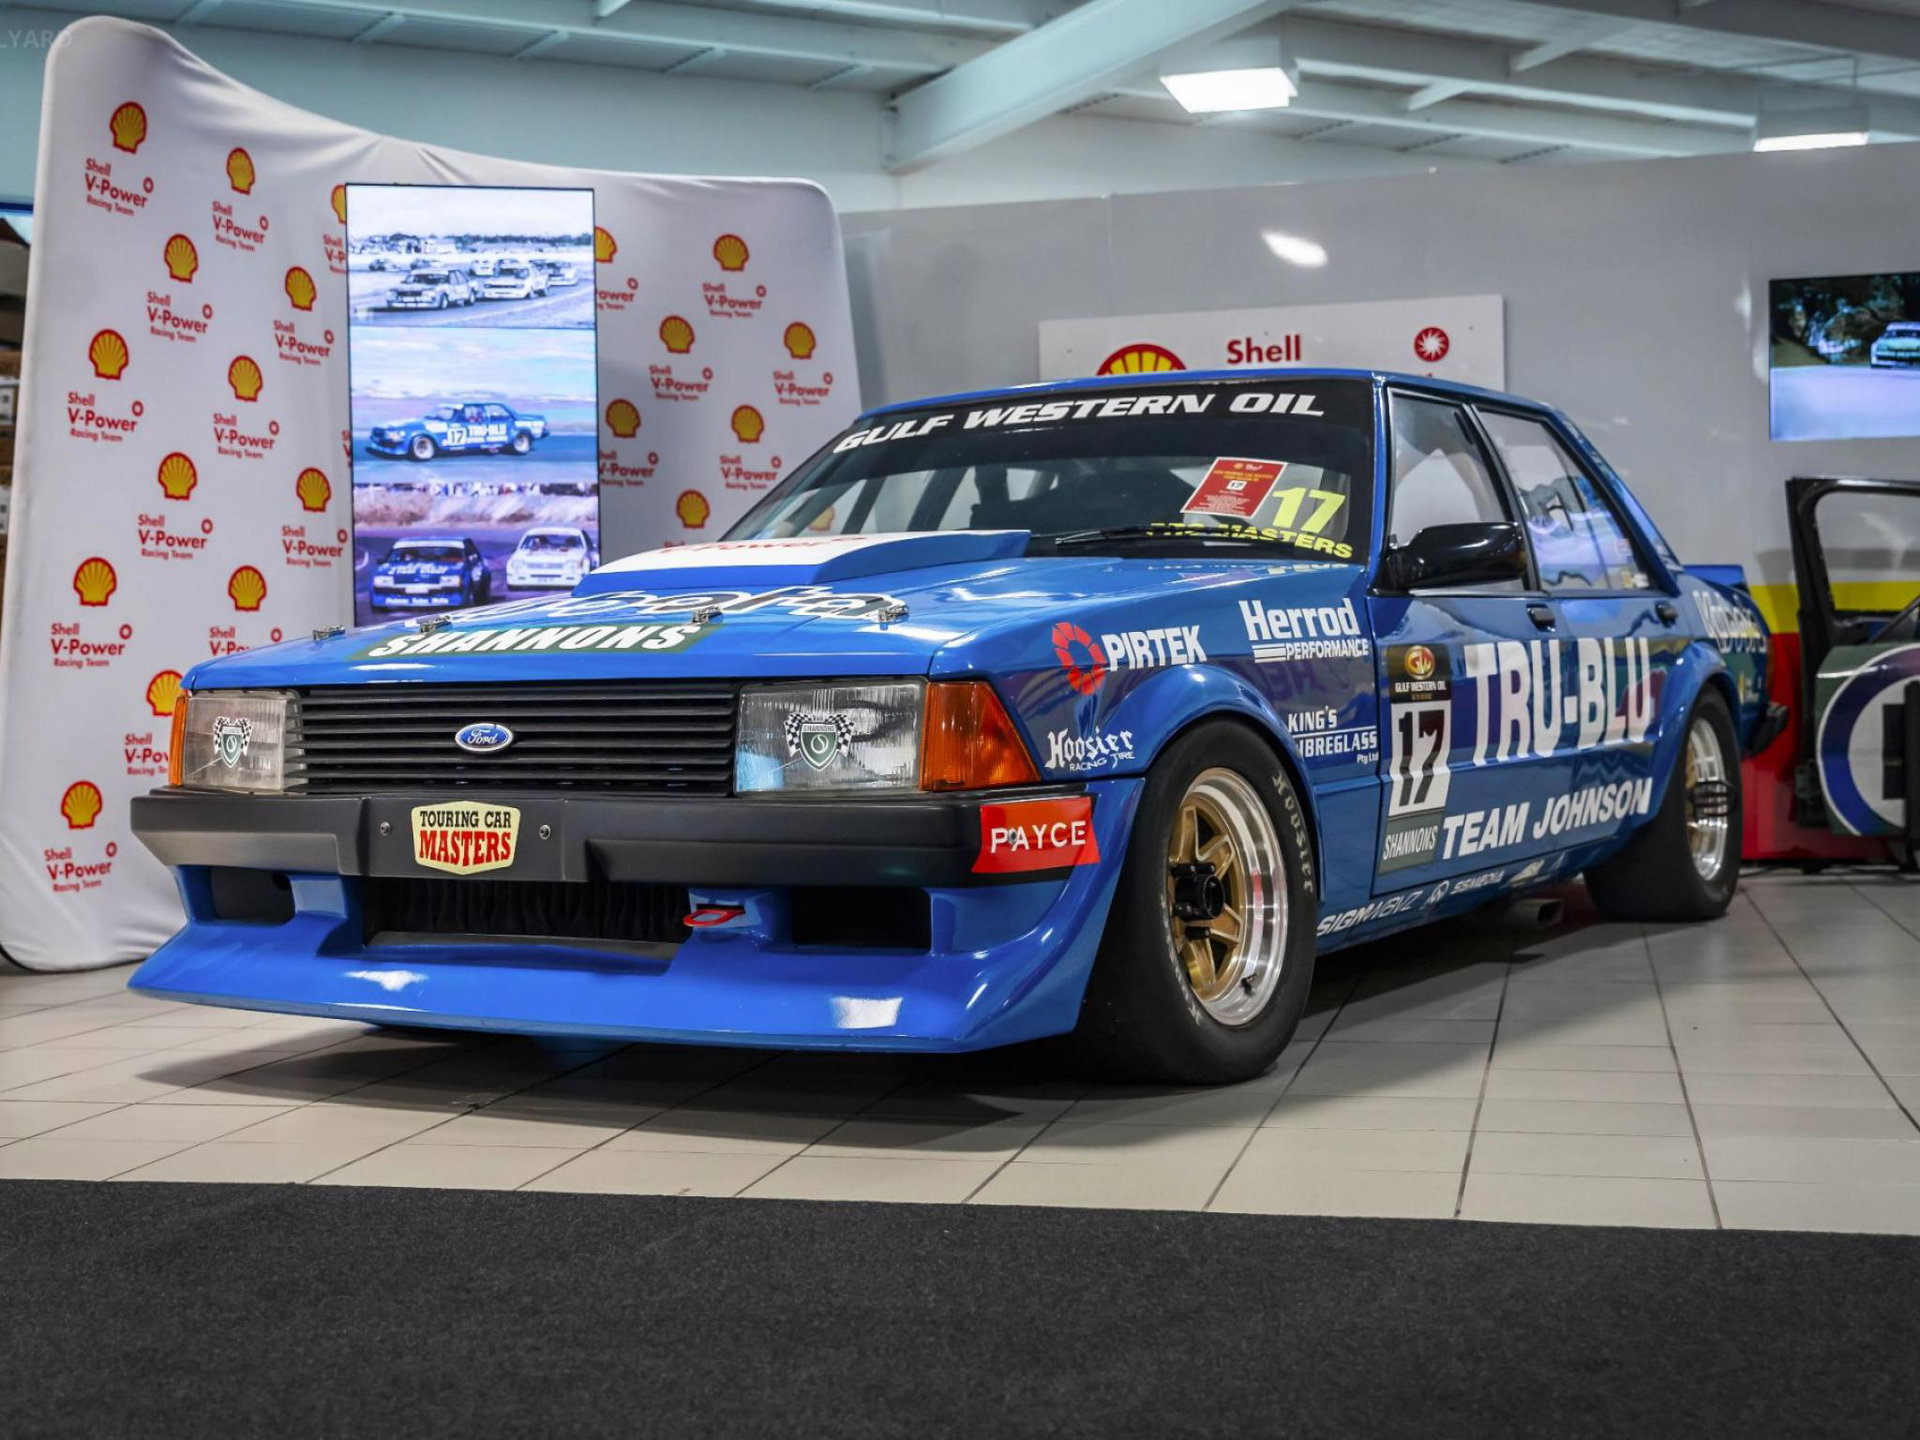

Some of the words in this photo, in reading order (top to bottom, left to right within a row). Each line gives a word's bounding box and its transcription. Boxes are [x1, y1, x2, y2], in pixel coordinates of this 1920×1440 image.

[86, 158, 111, 176] Shell
[85, 172, 147, 208] V-Power
[212, 201, 232, 216] Shell
[213, 215, 265, 244] V-Power
[598, 290, 635, 303] ower
[703, 283, 725, 293] Shell
[147, 292, 170, 306] Shell
[705, 294, 762, 310] V-Power
[147, 306, 208, 333] V-Power
[274, 320, 295, 333] Shell
[275, 333, 330, 357] V-Power
[1227, 335, 1301, 365] Shell
[649, 365, 671, 375] Shell
[773, 371, 794, 381] Shell
[651, 377, 709, 393] V-Power
[775, 383, 829, 397] V-Power
[68, 392, 95, 407] Shell
[68, 407, 137, 432] V-Power
[214, 413, 237, 427] Shell
[833, 414, 954, 453] GULF
[963, 393, 1215, 429] WESTERN
[1229, 393, 1325, 417] OIL
[70, 428, 98, 442] Racing
[101, 431, 123, 442] Team
[214, 427, 275, 450] V-Power
[450, 430, 464, 444] 17
[600, 449, 617, 460] hell
[720, 455, 741, 465] Shell
[721, 467, 778, 481] V-Power
[1272, 487, 1346, 534] 17
[138, 514, 165, 527] Shell
[138, 529, 207, 549] V-Power
[282, 525, 305, 538] Shell
[141, 549, 168, 561] Racing
[171, 550, 193, 560] Team
[282, 539, 343, 557] V-Power
[1239, 598, 1360, 641] Herrod
[51, 623, 80, 636] Shell
[210, 627, 235, 639] Shell
[51, 638, 125, 656] V-Power
[369, 625, 702, 657] SHANNONS
[1101, 624, 1207, 672] PIRTEK
[1284, 639, 1369, 661] PERFORMANCE
[54, 657, 84, 669] Racing
[86, 658, 109, 667] Team
[1464, 637, 1653, 767] TRU-BLU
[1288, 705, 1338, 733] KING'S
[125, 734, 152, 745] Shell
[466, 728, 498, 745] Ford
[1298, 731, 1378, 758] IBREGLASS
[1044, 725, 1134, 769] Hoosier
[1069, 757, 1107, 771] RACING
[1110, 751, 1136, 769] TIRE
[1397, 707, 1446, 806] 17
[420, 810, 479, 828] TOURING
[484, 811, 511, 828] CAR
[1442, 802, 1531, 860] TEAM
[1533, 777, 1654, 838] JOHNSON
[991, 820, 1086, 854] PAYCE
[1383, 826, 1438, 860] SHANNONS
[45, 849, 72, 861] Shell
[419, 830, 511, 867] MASTERS
[46, 860, 112, 880] V-Power
